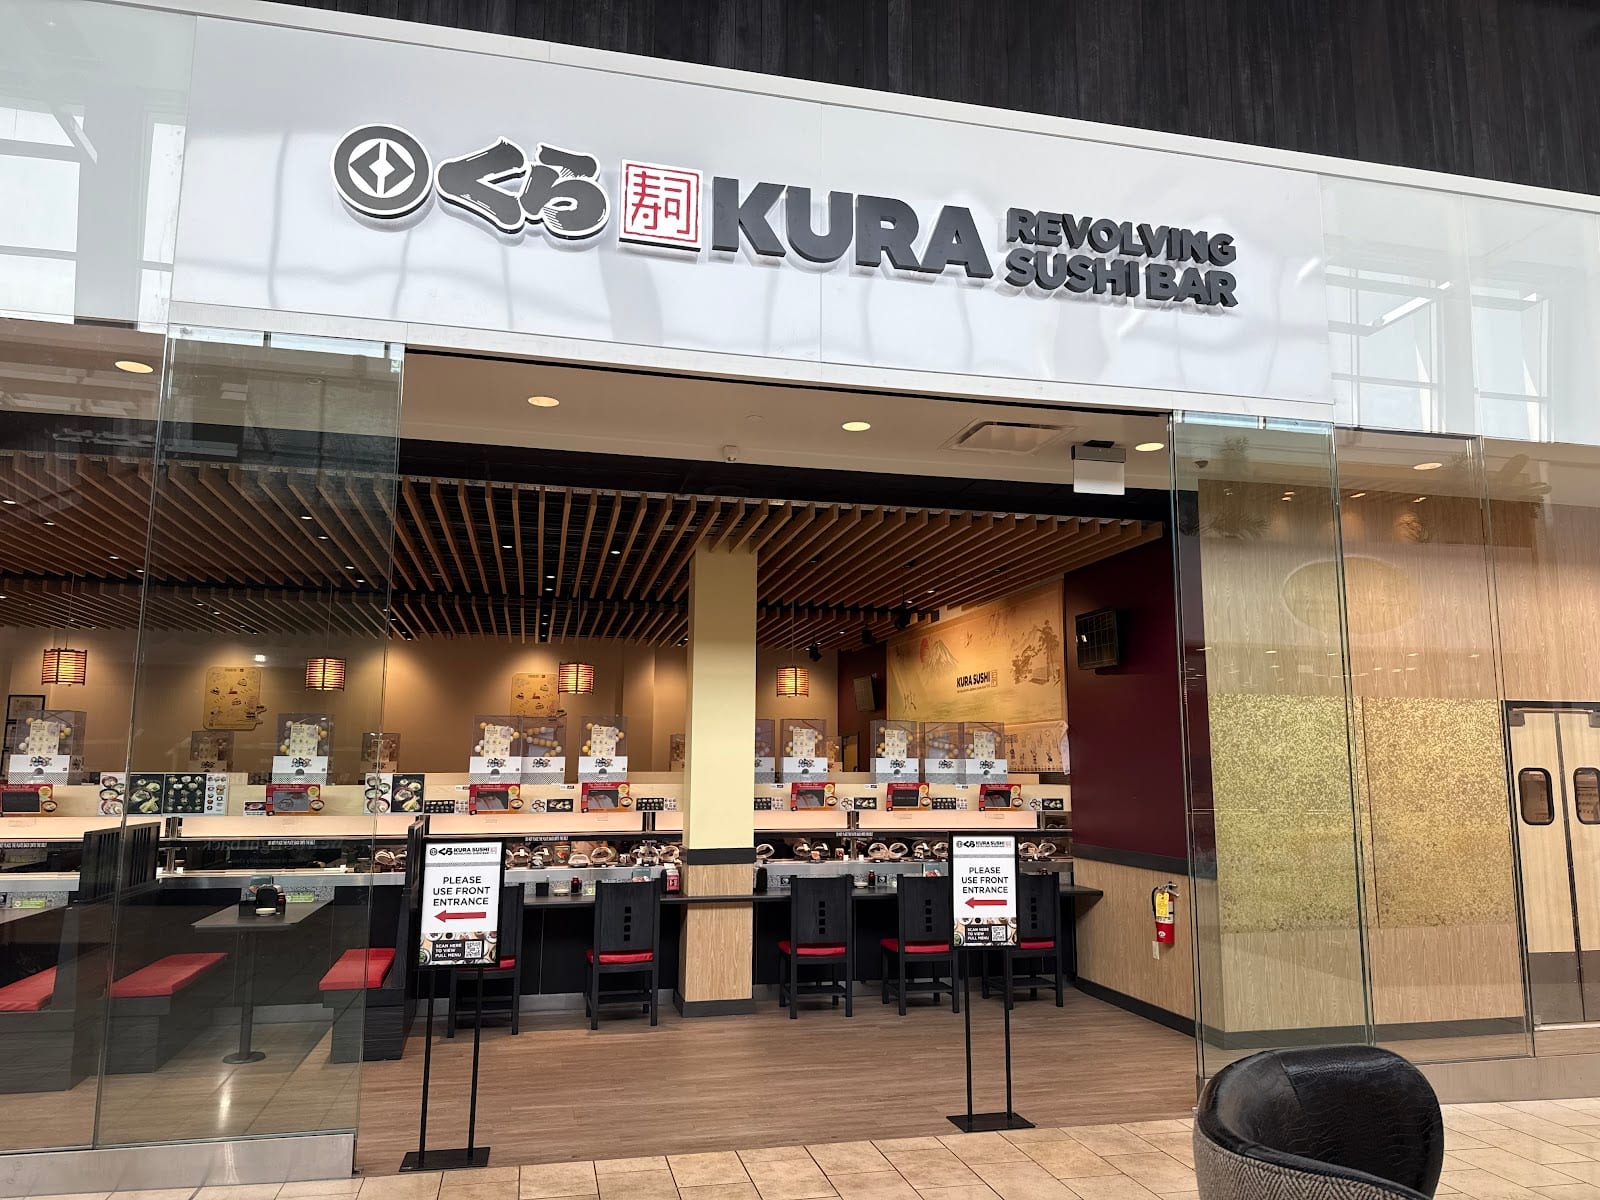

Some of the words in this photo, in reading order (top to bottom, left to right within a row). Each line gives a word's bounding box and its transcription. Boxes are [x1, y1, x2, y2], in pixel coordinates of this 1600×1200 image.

[435, 136, 611, 240] くら
[628, 167, 697, 239] 寿司
[711, 176, 993, 280] KURA
[1006, 207, 1237, 266] REVOLVING
[1004, 249, 1140, 298] SUSHI
[1145, 263, 1239, 308] BAR
[956, 675, 972, 688] KURA
[973, 672, 990, 684] SUSHI
[969, 866, 1001, 874] PLEASE
[443, 876, 482, 884] PLEASE
[961, 876, 978, 884] USE
[980, 876, 1009, 884] FRONT
[433, 888, 453, 896] USE
[455, 887, 491, 895] FRONT
[962, 886, 1009, 894] ENTRANCE
[433, 897, 489, 907] ENTRANCE
